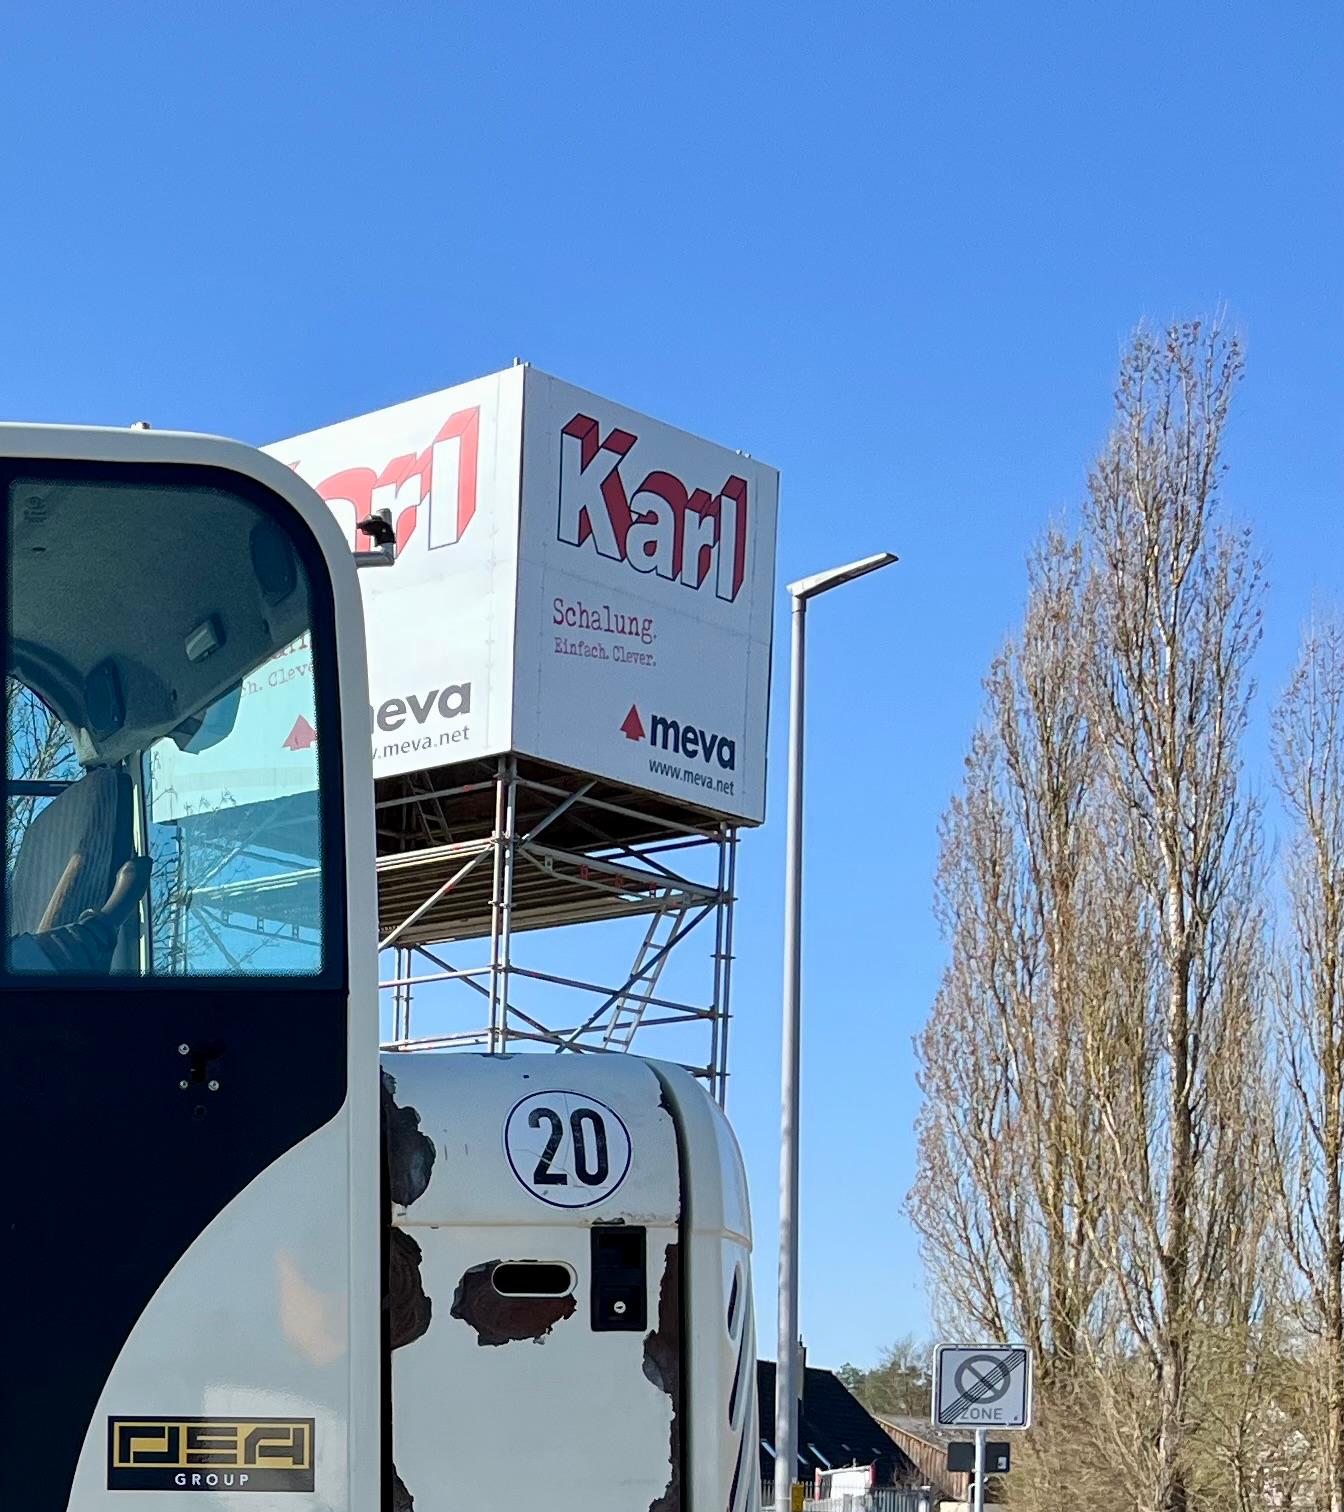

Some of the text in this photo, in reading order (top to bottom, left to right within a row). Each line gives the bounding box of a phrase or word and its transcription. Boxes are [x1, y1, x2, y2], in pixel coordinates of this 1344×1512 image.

[556, 412, 748, 603] Karl
[552, 598, 657, 645] Schalung.
[553, 637, 657, 667] Einfach. Clever.
[368, 681, 472, 735] eva
[371, 725, 471, 760] .meva.net
[649, 713, 736, 771] meva
[648, 758, 735, 796] www.meva.net
[527, 1107, 610, 1187] 20
[960, 1407, 1004, 1420] ZONE
[174, 1473, 251, 1487] GROUP
